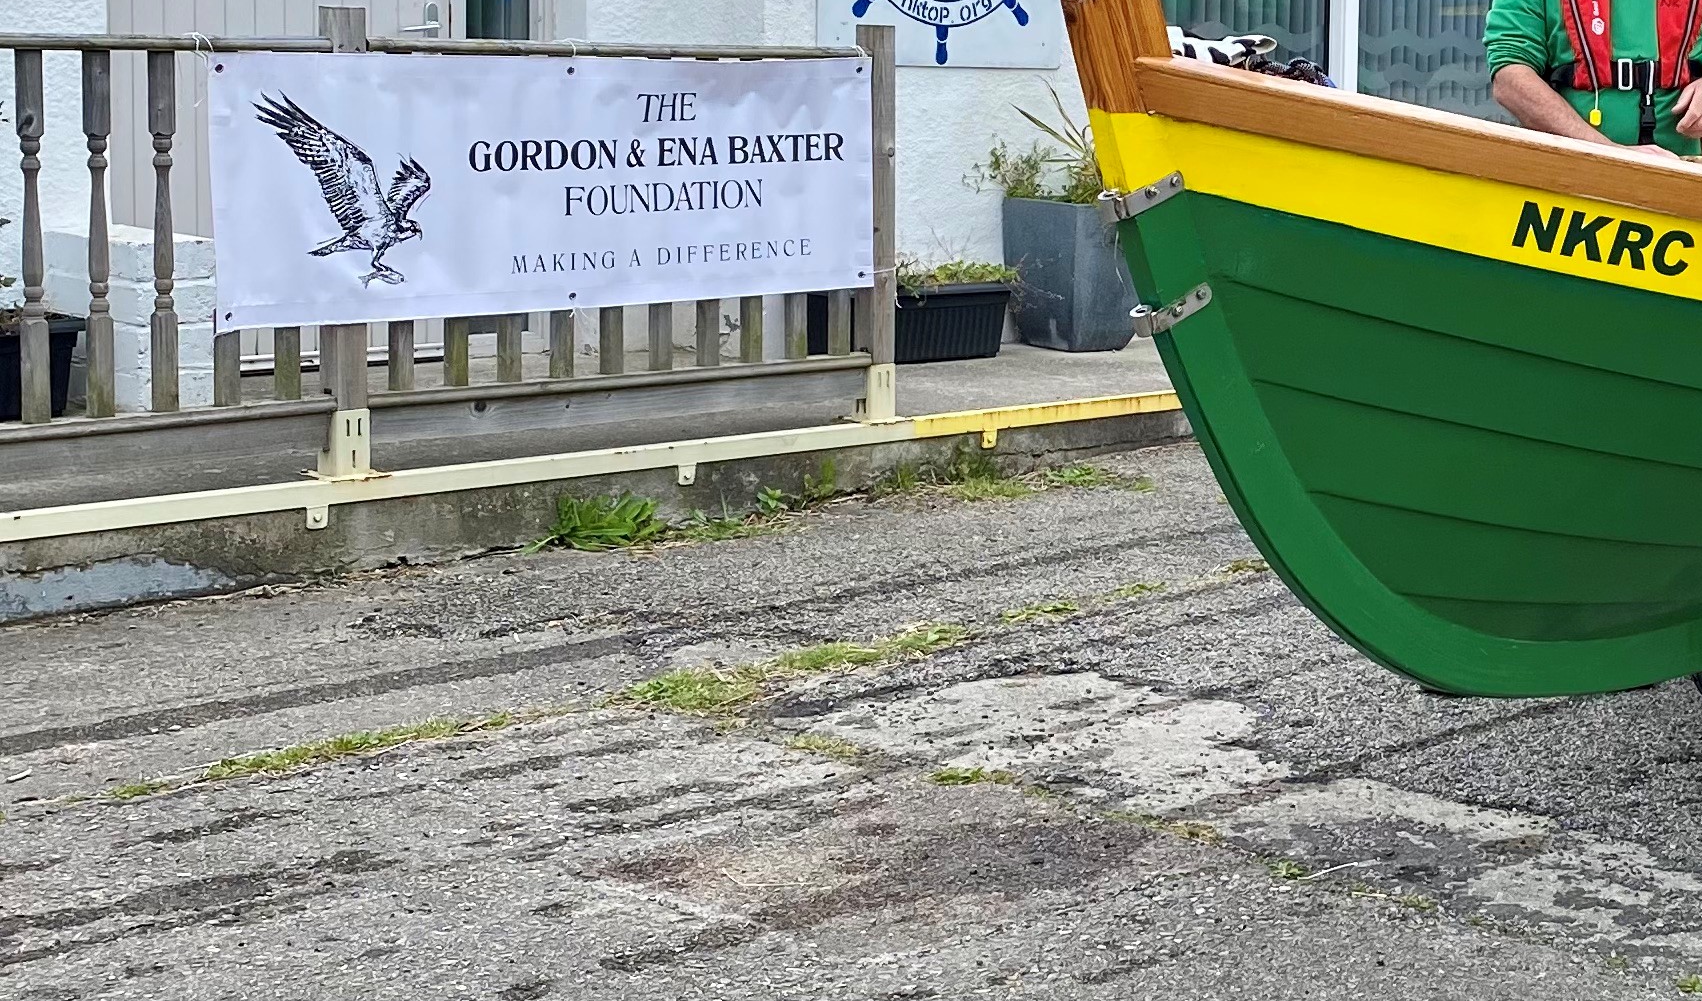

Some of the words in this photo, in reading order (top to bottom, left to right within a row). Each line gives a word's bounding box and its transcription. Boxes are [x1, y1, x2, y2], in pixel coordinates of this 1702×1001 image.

[636, 92, 697, 122] THE
[469, 139, 617, 172] GORDON
[626, 138, 646, 168] &
[657, 137, 718, 166] ENA
[728, 133, 845, 164] BAXTER
[564, 179, 763, 216] FOUNDATION
[511, 251, 616, 274] MAKING
[628, 248, 641, 267] A
[657, 238, 811, 265] DIFFERENCE
[1511, 200, 1695, 276] NKRC
